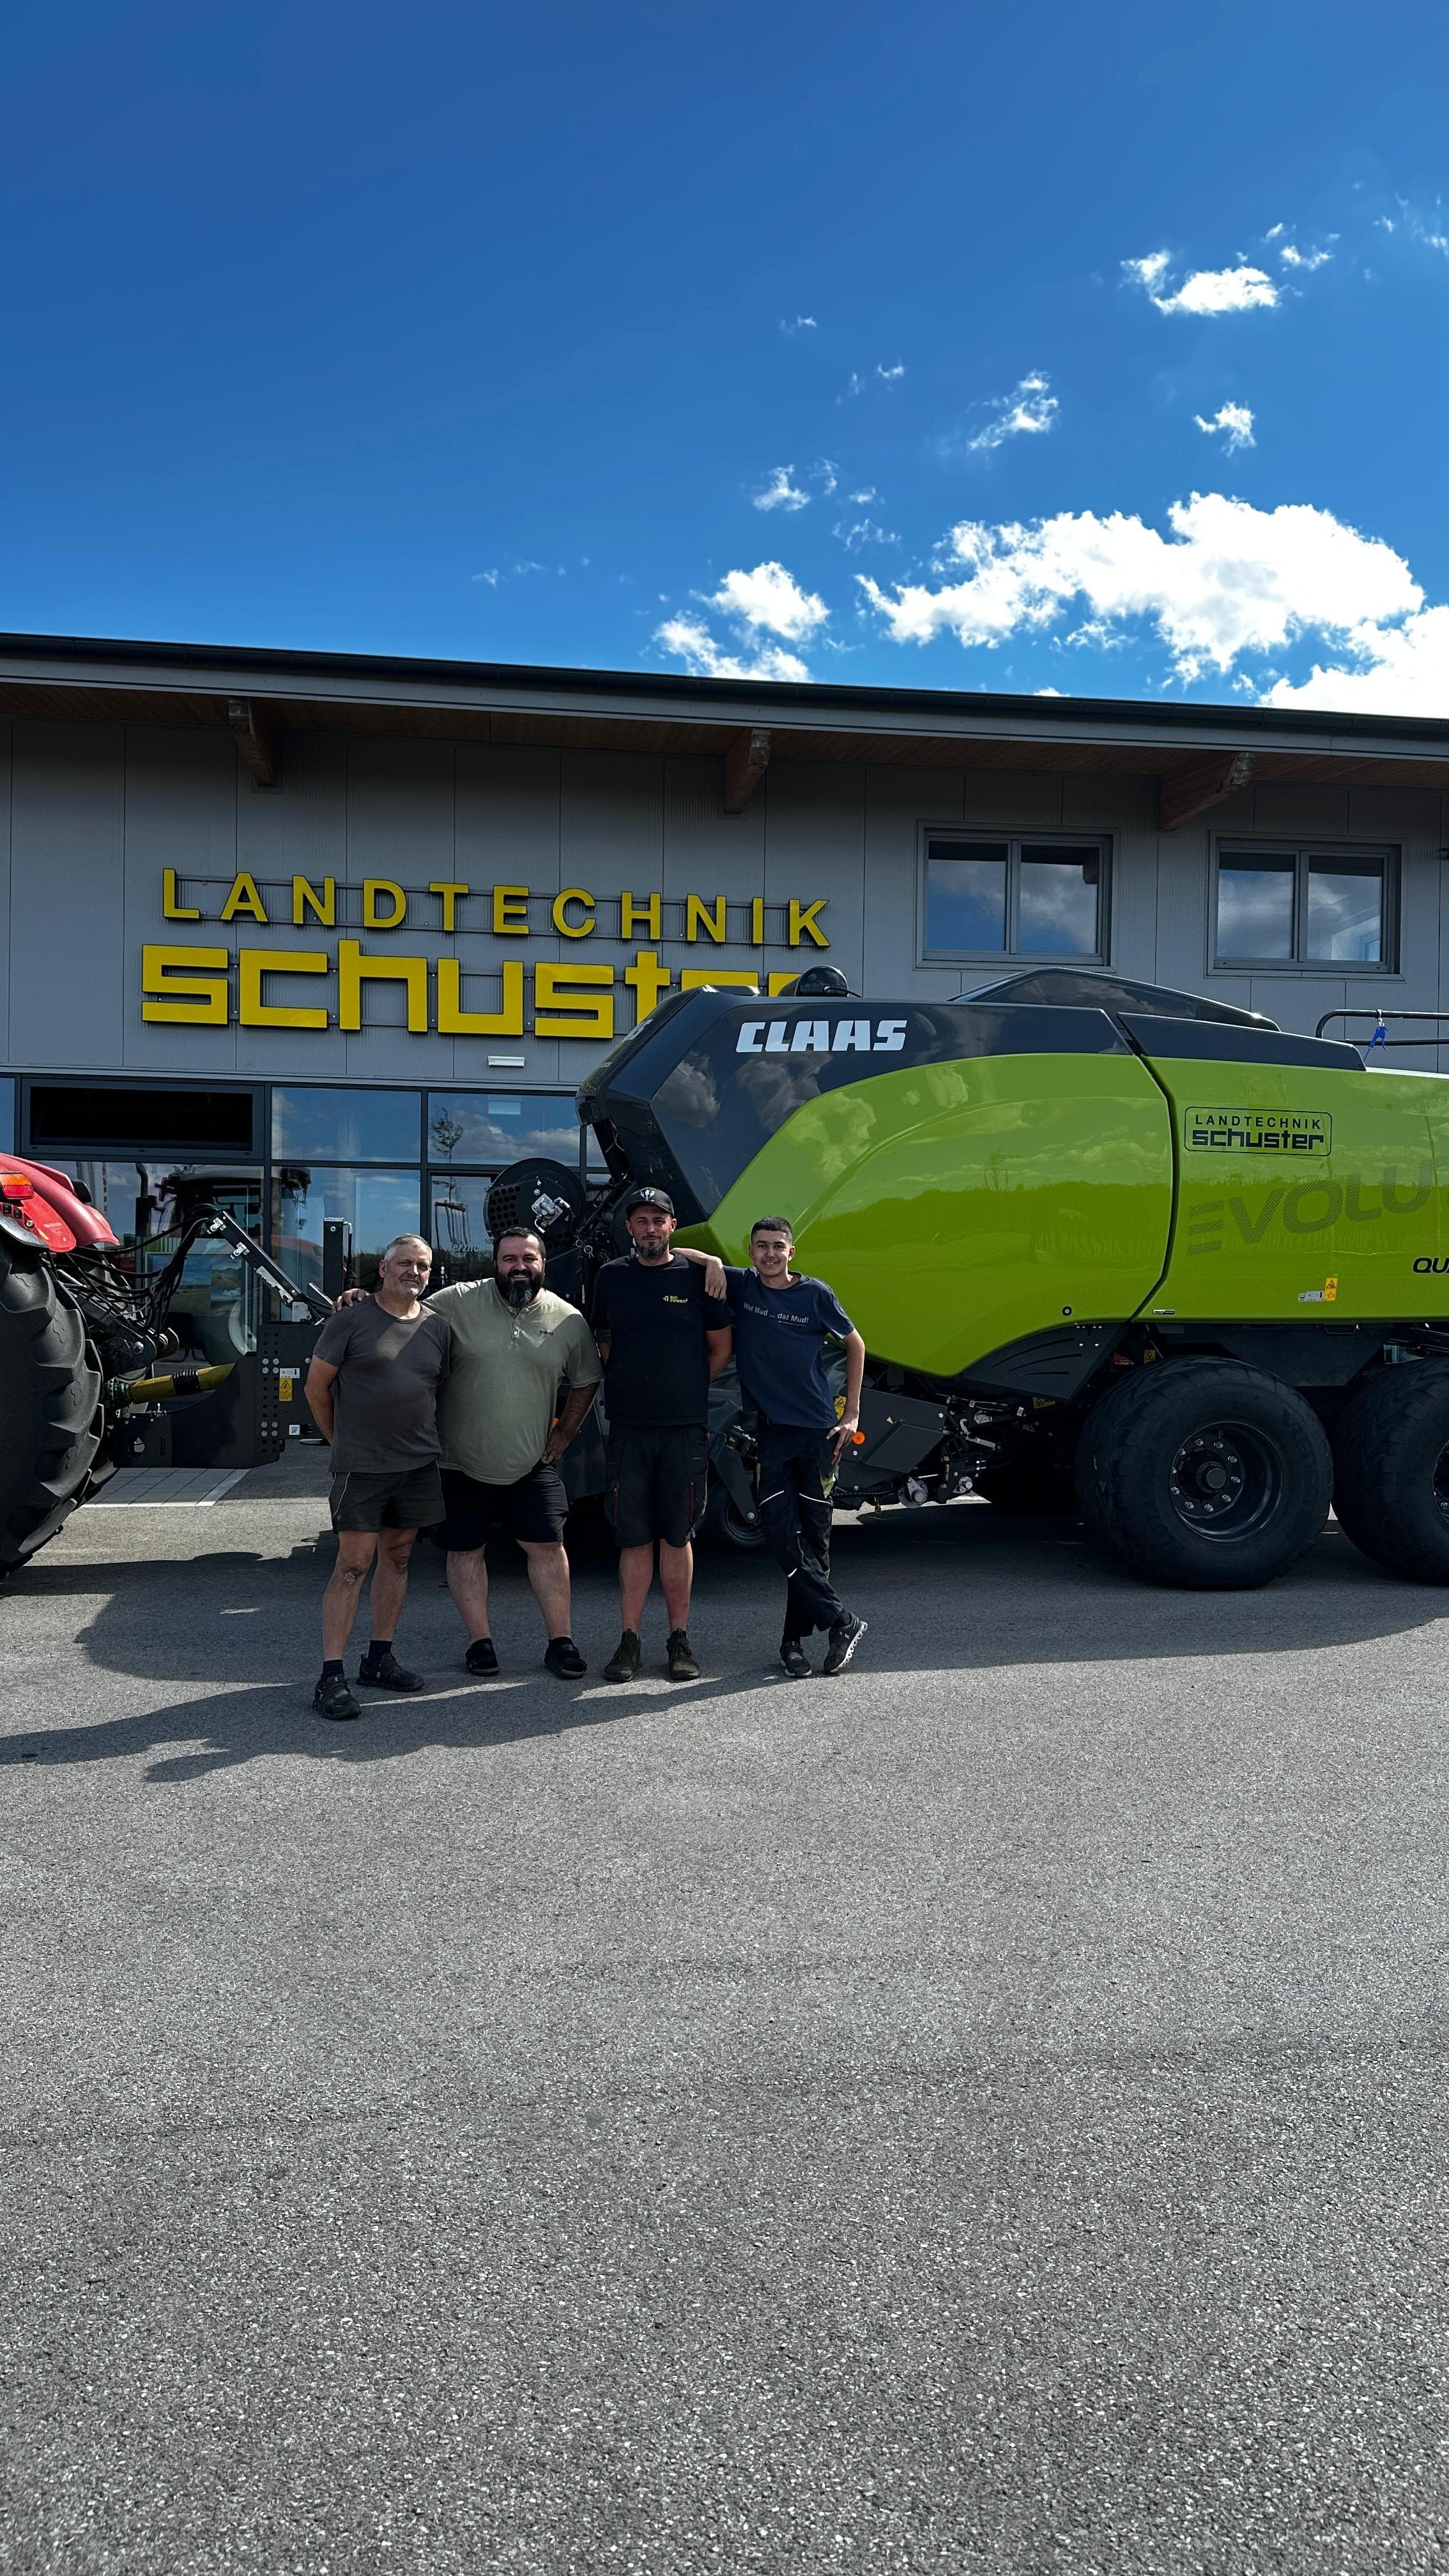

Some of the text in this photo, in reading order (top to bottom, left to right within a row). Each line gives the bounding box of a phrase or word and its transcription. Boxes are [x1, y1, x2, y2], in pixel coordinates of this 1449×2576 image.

[162, 868, 830, 947] LANDTECHNIK
[735, 1020, 907, 1053] CLAAS
[1195, 1114, 1321, 1130] LANDTECHNIK
[1192, 1128, 1324, 1150] schuster
[1413, 1257, 1449, 1273] QU
[755, 1307, 768, 1316] Mud
[777, 1312, 789, 1321] dat
